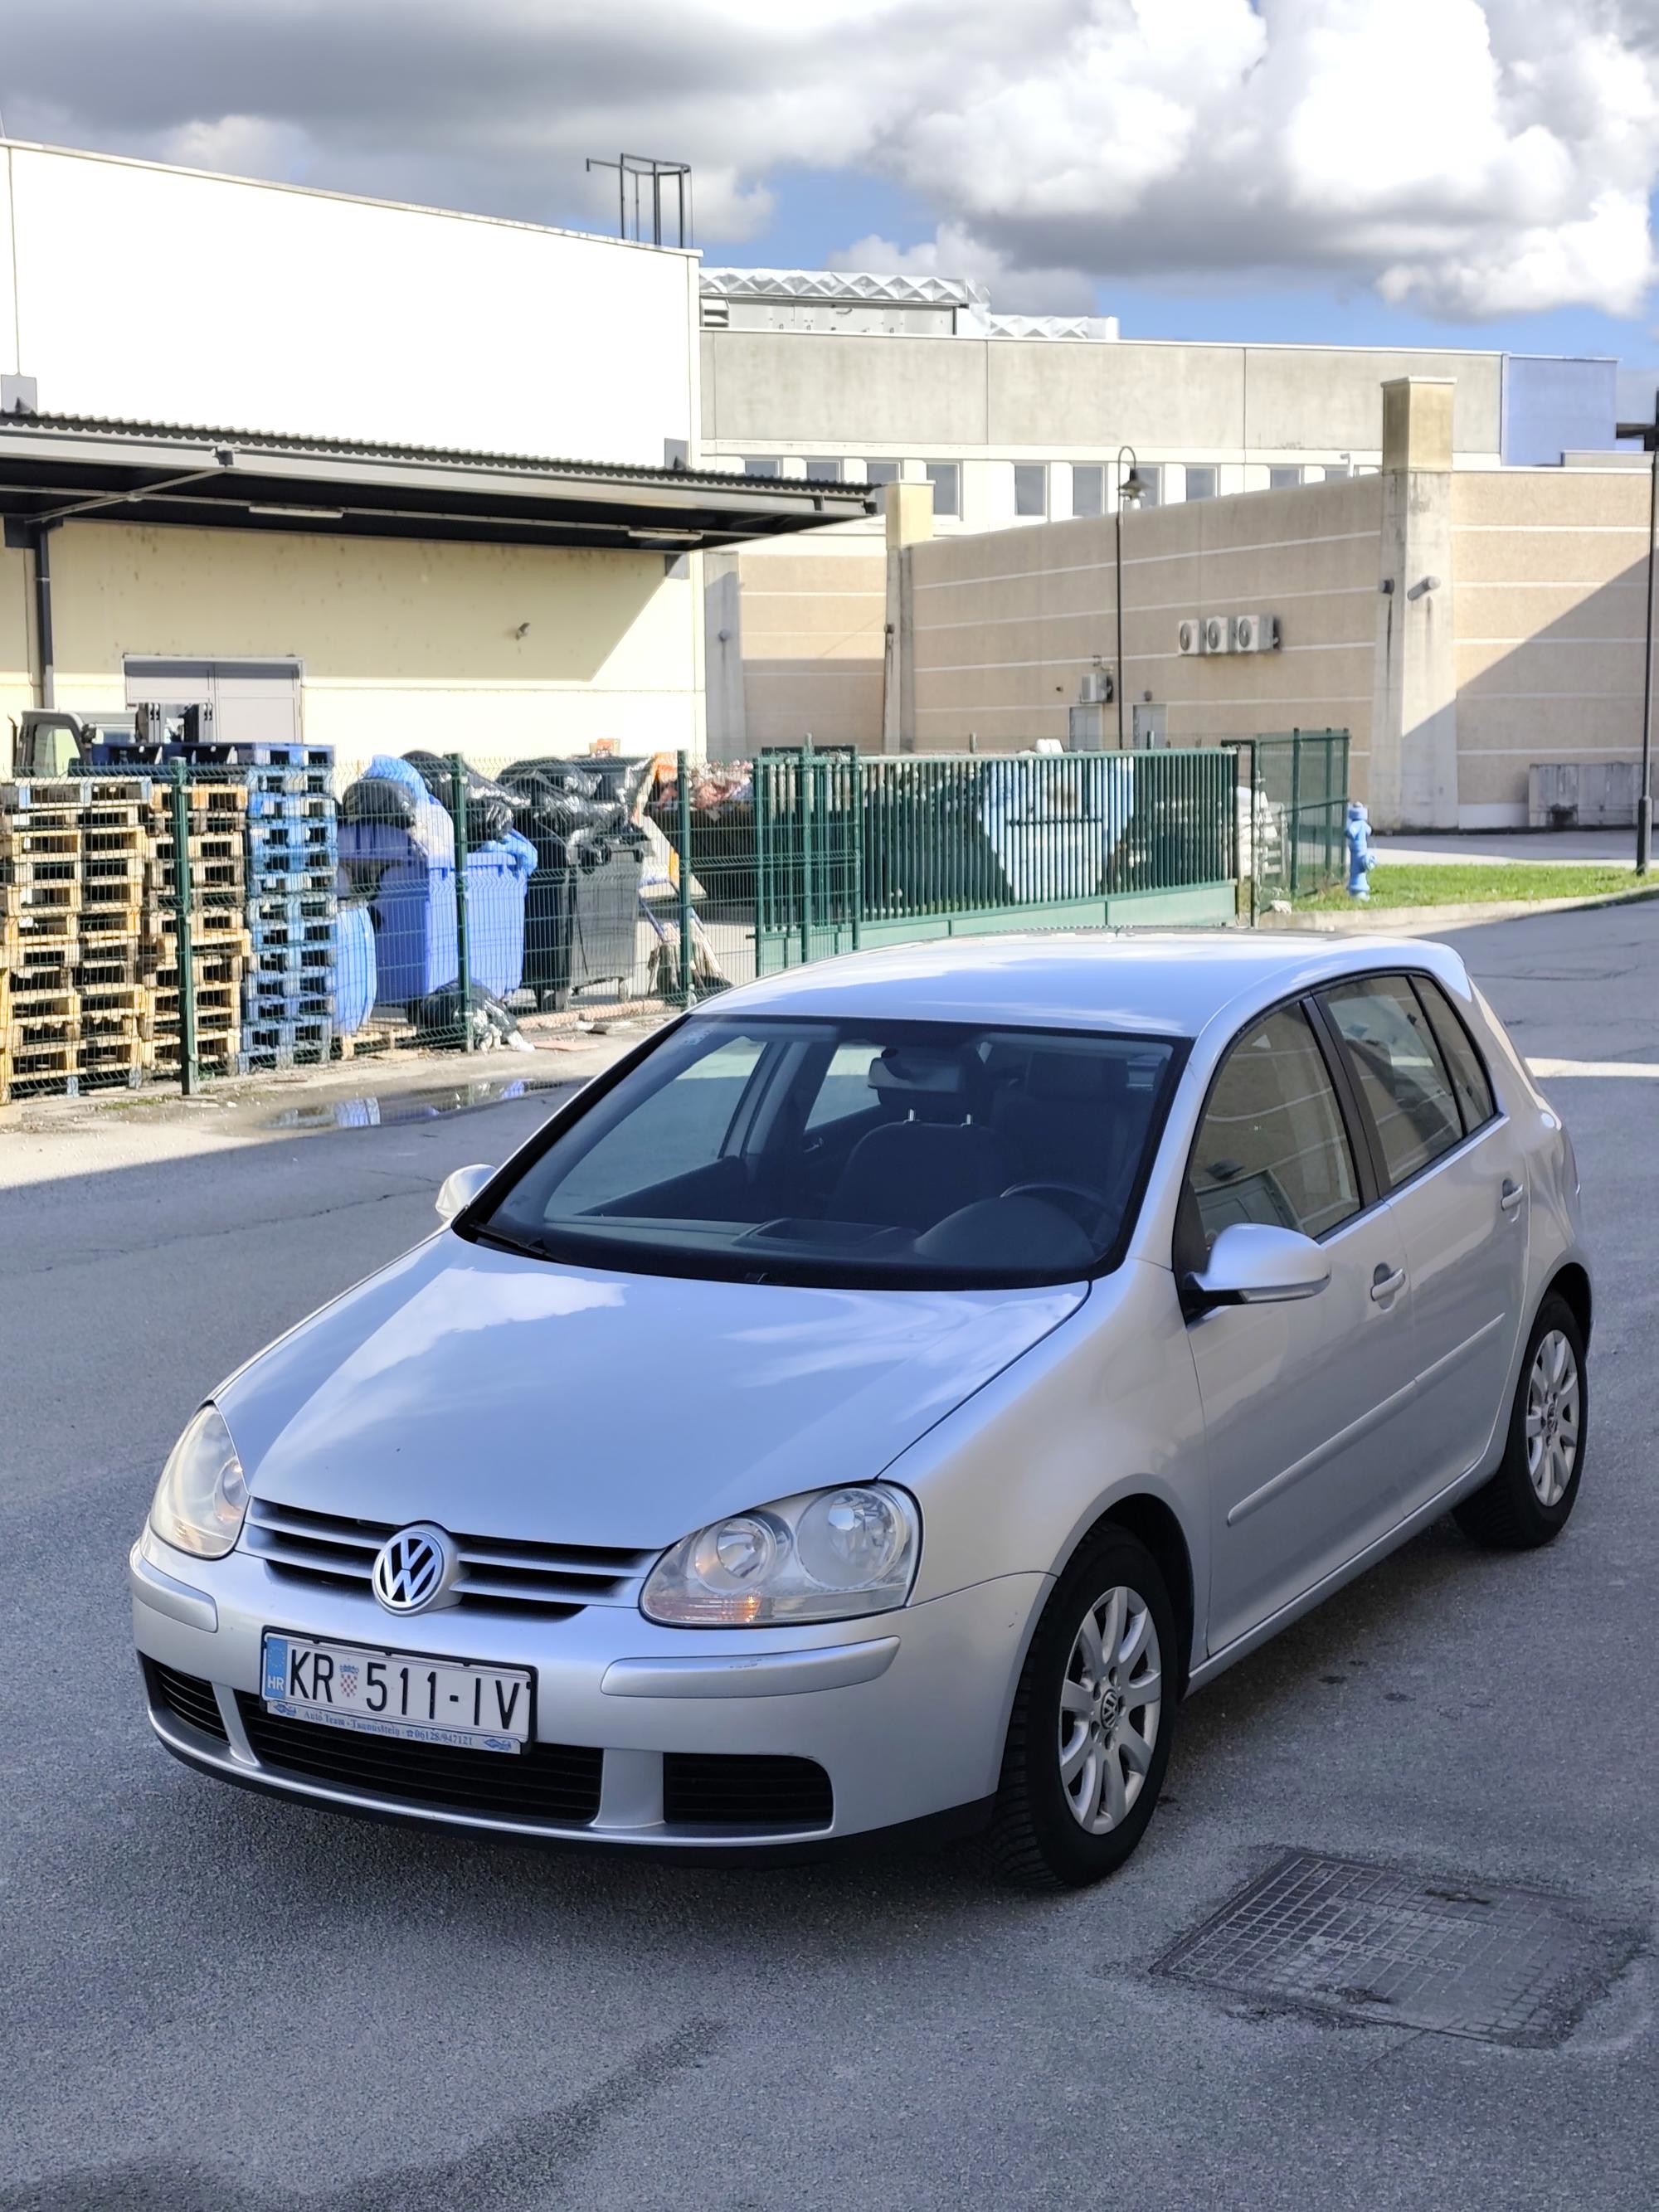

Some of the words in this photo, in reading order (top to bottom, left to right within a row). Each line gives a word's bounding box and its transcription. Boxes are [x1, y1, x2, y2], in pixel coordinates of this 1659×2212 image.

[375, 1531, 443, 1609] VW
[267, 1675, 285, 1691] HR
[290, 1648, 334, 1704] KR
[366, 1661, 520, 1730] 511-IV
[304, 1710, 323, 1722] Auto
